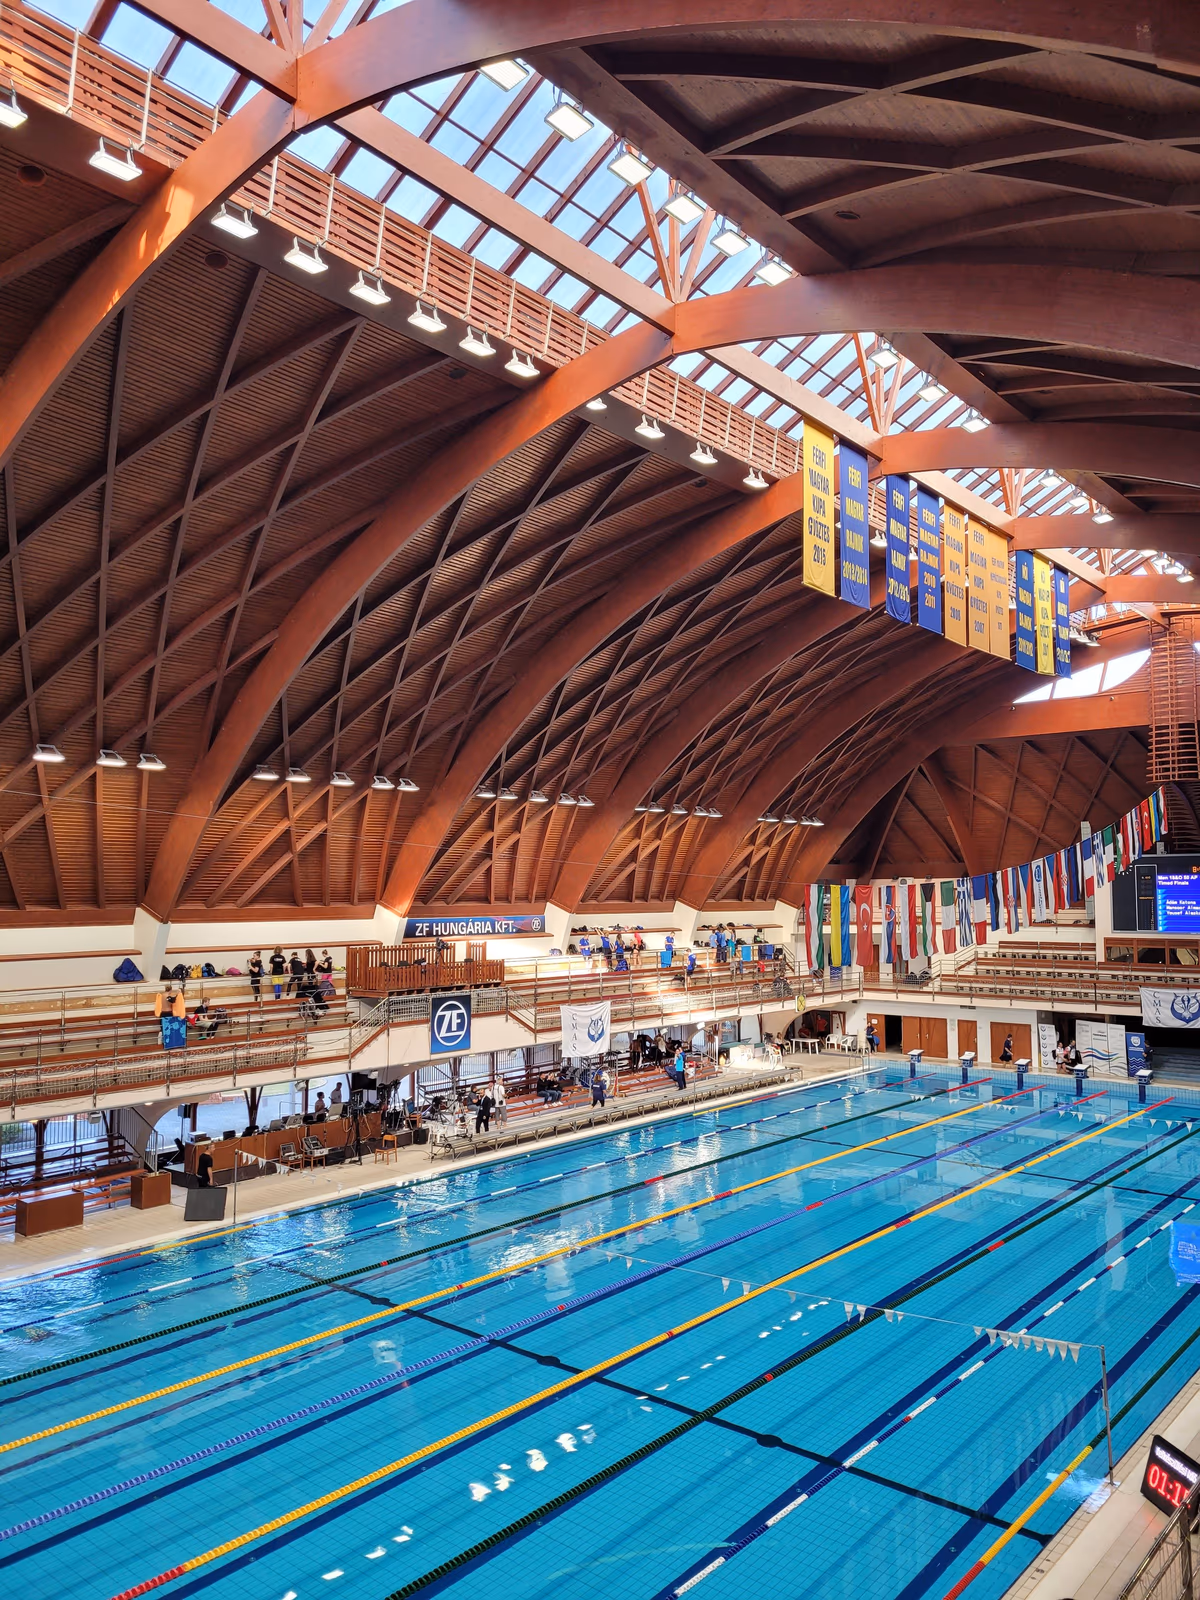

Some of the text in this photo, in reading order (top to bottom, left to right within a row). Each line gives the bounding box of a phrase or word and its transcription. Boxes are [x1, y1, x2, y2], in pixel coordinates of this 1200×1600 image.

[812, 444, 826, 470] FÉRFI
[808, 467, 829, 496] MAGYAR
[848, 465, 862, 489] FÉRFI
[812, 494, 826, 518] KUPA
[845, 497, 864, 522] MAGYAR
[892, 488, 905, 512] FÉRFI
[922, 507, 936, 528] FÉRFI
[948, 512, 961, 530] FÉRFI
[845, 529, 864, 553] BAJNOK
[889, 519, 907, 543] MAGYAR
[919, 528, 939, 550] MAGYAR
[973, 528, 985, 546] FÉRFI
[813, 544, 826, 566] 2015
[945, 533, 963, 555] MAGYAR
[920, 549, 939, 570] BAJNOK
[949, 559, 961, 576] KUPA
[970, 550, 987, 570] MAGYAR
[923, 571, 937, 589] 2010
[973, 574, 985, 590] KUPA
[924, 592, 936, 610] 2011
[415, 918, 516, 936] ZF HUNGÁRIA KFT.
[532, 917, 541, 931] ZF
[436, 1008, 466, 1038] ZF
